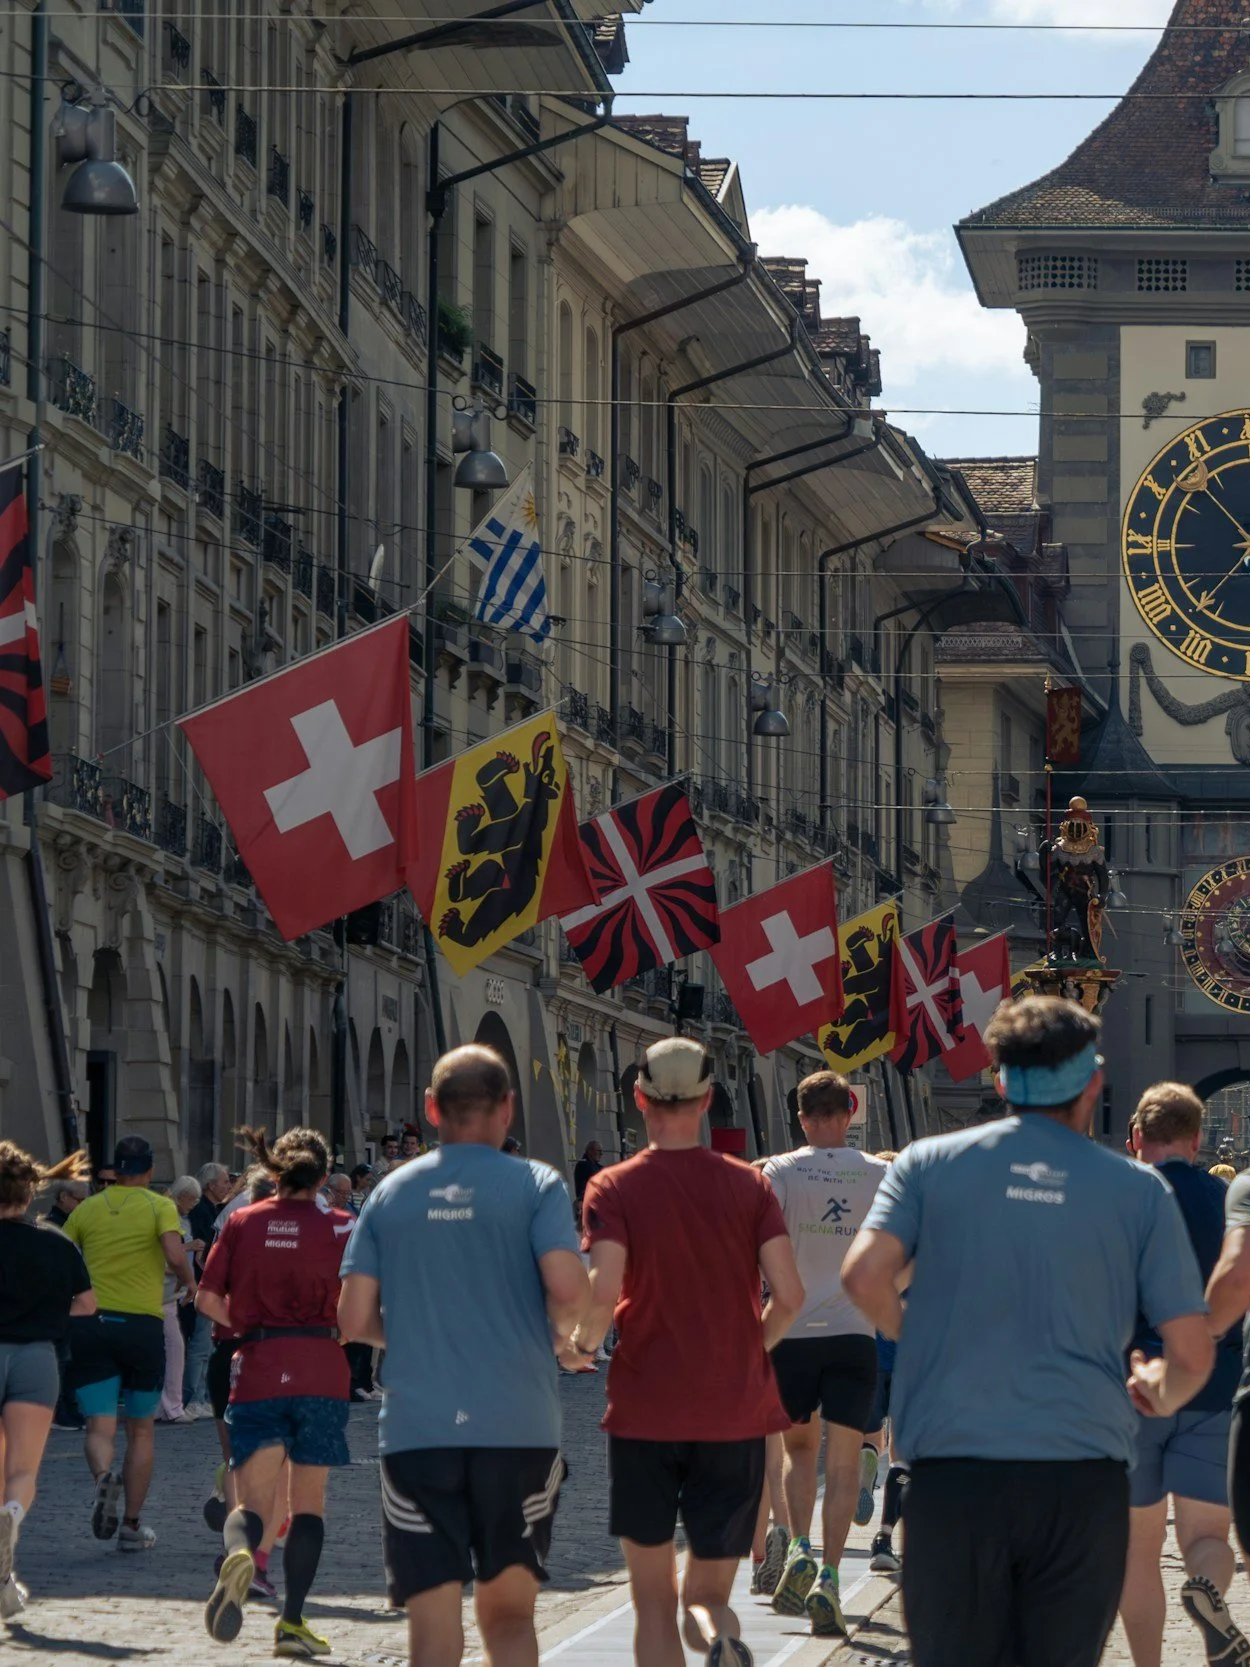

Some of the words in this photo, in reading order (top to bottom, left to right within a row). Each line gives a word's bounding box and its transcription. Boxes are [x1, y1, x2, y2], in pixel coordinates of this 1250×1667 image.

[1006, 1186, 1065, 1204] MIGROS
[428, 1207, 473, 1220] MIGROS
[264, 1239, 298, 1248] MIGROS
